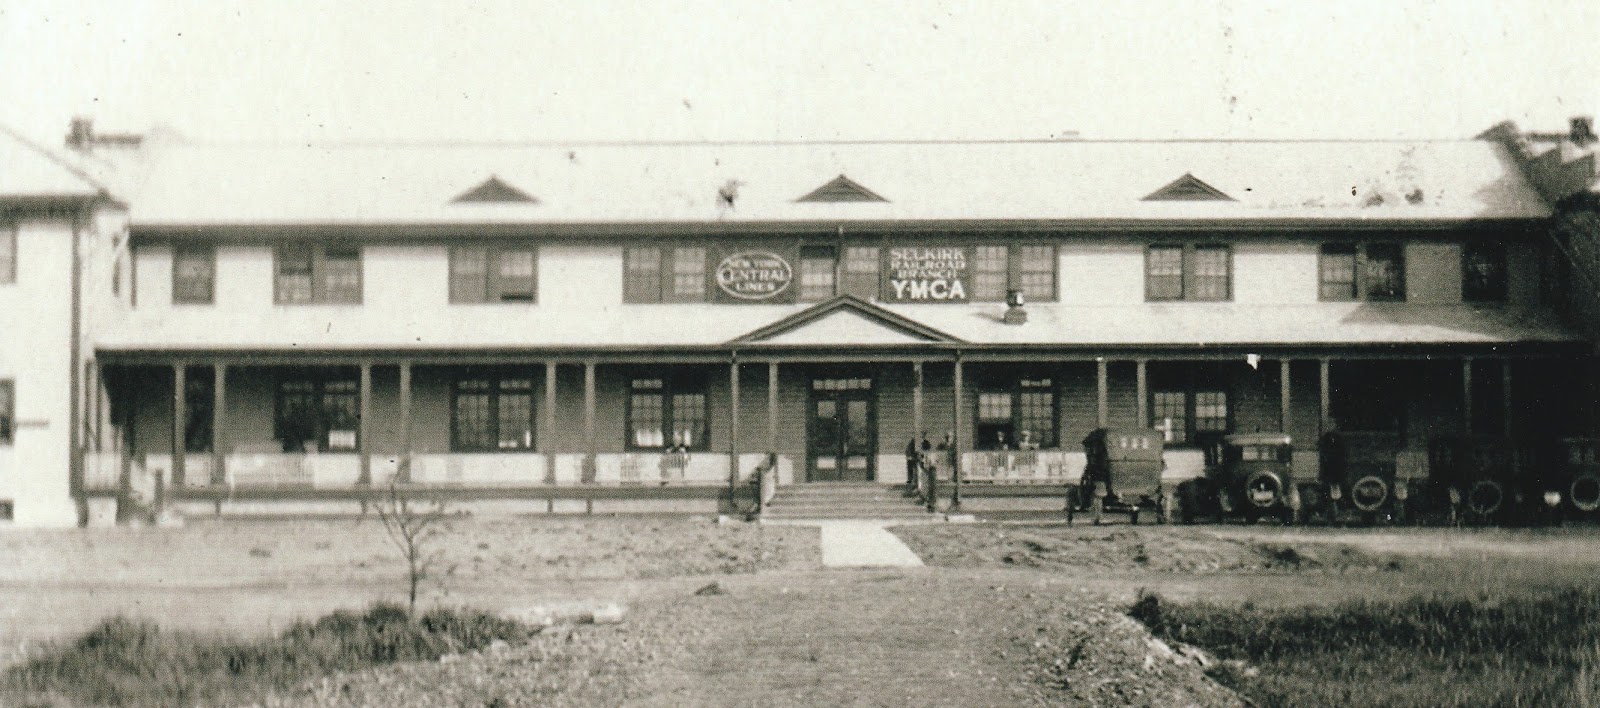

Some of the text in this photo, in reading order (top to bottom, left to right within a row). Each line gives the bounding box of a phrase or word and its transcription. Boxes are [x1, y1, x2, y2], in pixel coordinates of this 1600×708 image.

[890, 247, 965, 260] SELKIRK
[890, 260, 966, 270] RAILROAD
[717, 267, 786, 282] CENTRAL
[898, 269, 958, 279] BRANCH
